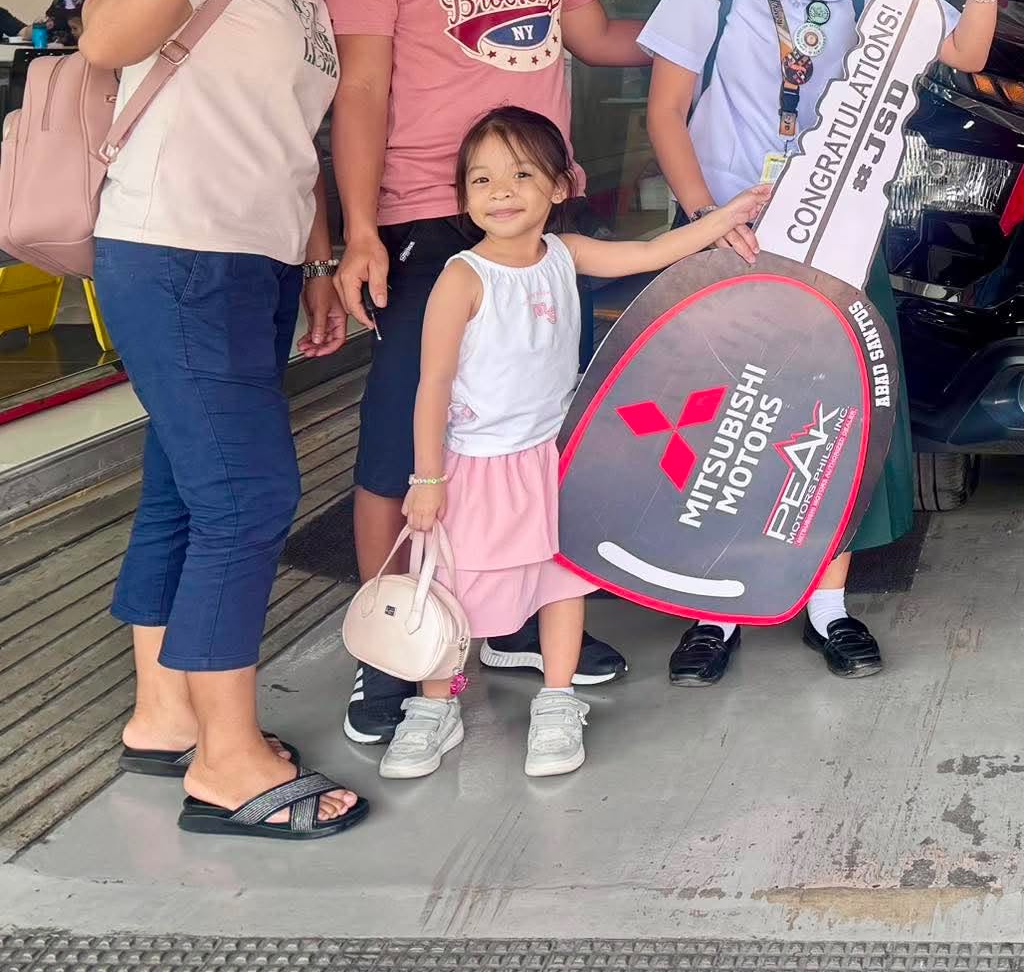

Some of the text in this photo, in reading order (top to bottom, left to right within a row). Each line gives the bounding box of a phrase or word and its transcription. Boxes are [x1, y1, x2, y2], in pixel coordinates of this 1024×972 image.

[511, 24, 534, 41] NY
[786, 3, 904, 244] CONGRATULATIONS!
[848, 300, 891, 408] ABAD SANTOS
[678, 363, 768, 529] MITSUBISHI
[715, 395, 784, 516] MOTORS
[766, 403, 841, 541] PEAK
[786, 483, 817, 544] MOTORS
